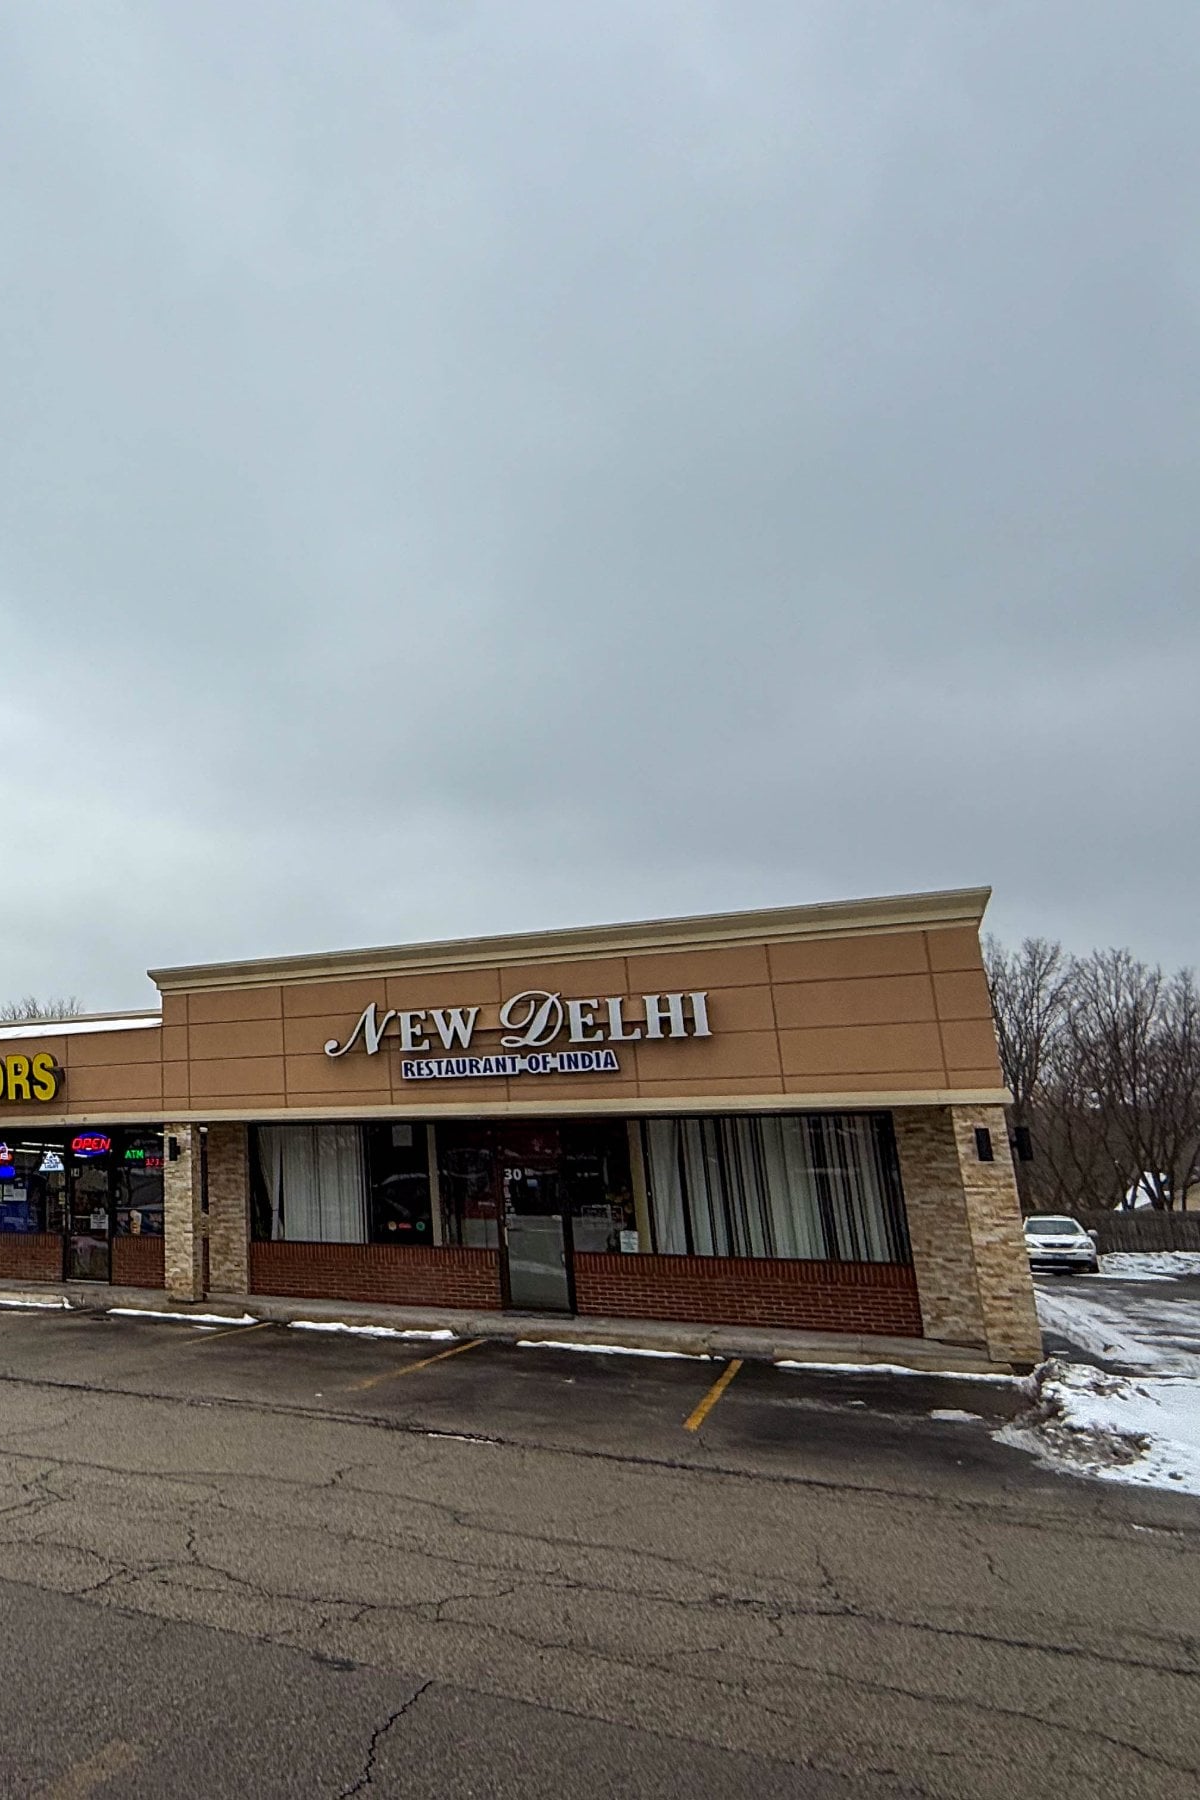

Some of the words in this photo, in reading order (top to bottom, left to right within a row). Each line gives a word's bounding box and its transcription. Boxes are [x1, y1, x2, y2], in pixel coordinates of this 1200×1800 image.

[324, 1002, 480, 1057] NEW
[499, 990, 713, 1048] DELHI
[402, 1055, 518, 1079] RESTAURANT
[527, 1055, 550, 1071] OF
[558, 1050, 617, 1070] INDIA
[71, 1137, 112, 1150] OPEN
[124, 1149, 144, 1159] ATM
[503, 1168, 522, 1181] 30
